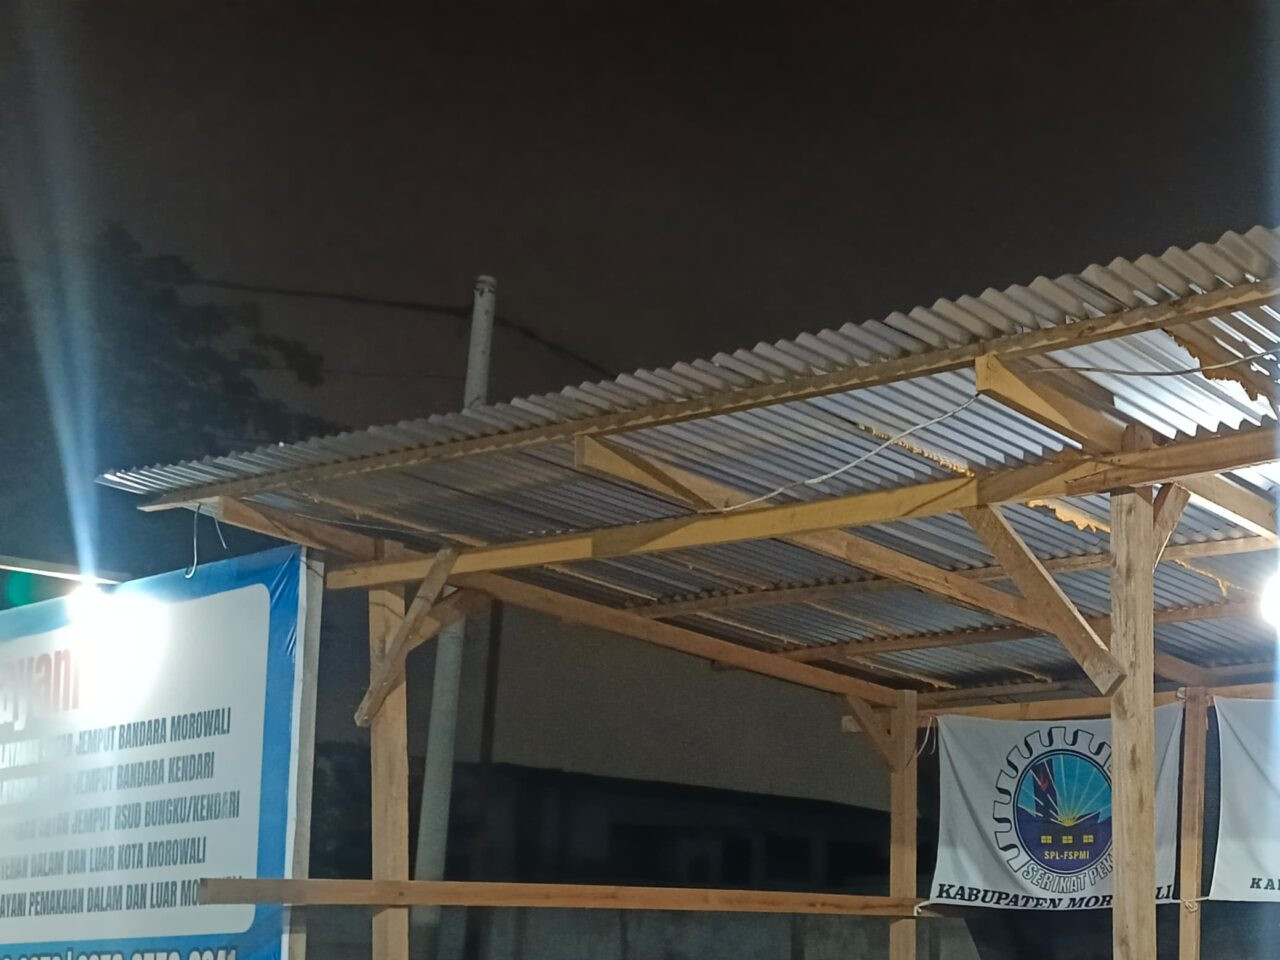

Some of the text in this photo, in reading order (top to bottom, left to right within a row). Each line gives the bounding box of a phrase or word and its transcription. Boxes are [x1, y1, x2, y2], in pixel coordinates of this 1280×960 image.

[76, 725, 116, 756] JEMPUT
[118, 717, 167, 751] BANDARA
[170, 707, 231, 744] MOROWALI
[117, 760, 165, 791] BANDARA
[168, 752, 215, 784] KENDARI
[72, 806, 112, 835] JEMPUT
[114, 802, 142, 831] RSUD
[144, 791, 240, 828] BUNGKU/KENDARI
[30, 850, 64, 878] DALAM
[67, 848, 86, 875] DAN
[89, 845, 115, 873] LUAR
[117, 843, 144, 870] KOTA
[147, 837, 207, 869] MOROWALI
[1044, 850, 1090, 860] SPL-FSPMI
[936, 883, 1060, 909] KABUPATEN
[1022, 863, 1087, 894] SERIKAT
[29, 888, 84, 917] PEMAKAIAN
[87, 884, 123, 912] DALAM
[126, 882, 147, 911] DAN
[150, 880, 178, 908] LUAR
